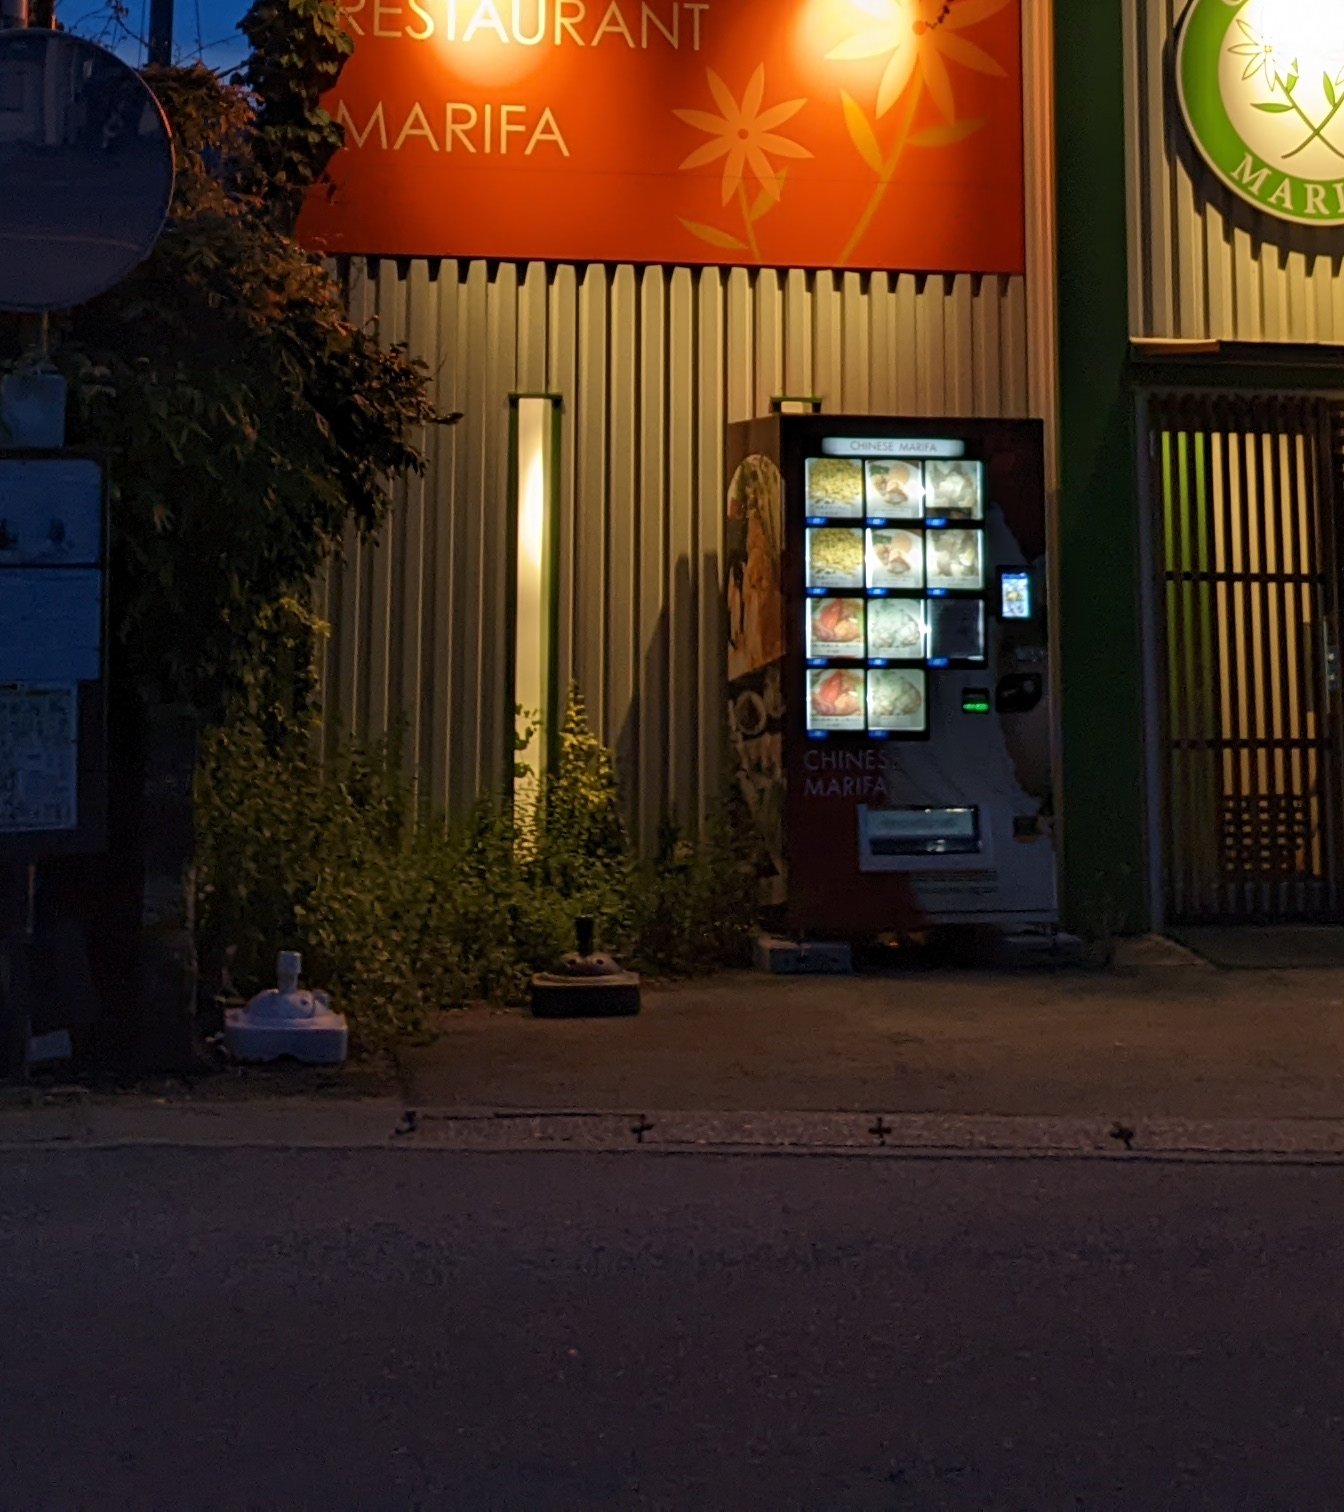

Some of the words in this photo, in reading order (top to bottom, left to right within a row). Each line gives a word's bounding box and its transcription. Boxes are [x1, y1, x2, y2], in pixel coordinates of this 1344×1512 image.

[337, 99, 570, 157] MARIFA
[850, 441, 894, 452] CHINESE
[899, 442, 937, 453] MARIFA
[804, 750, 899, 770] CHINES
[804, 776, 887, 796] MARIFA
